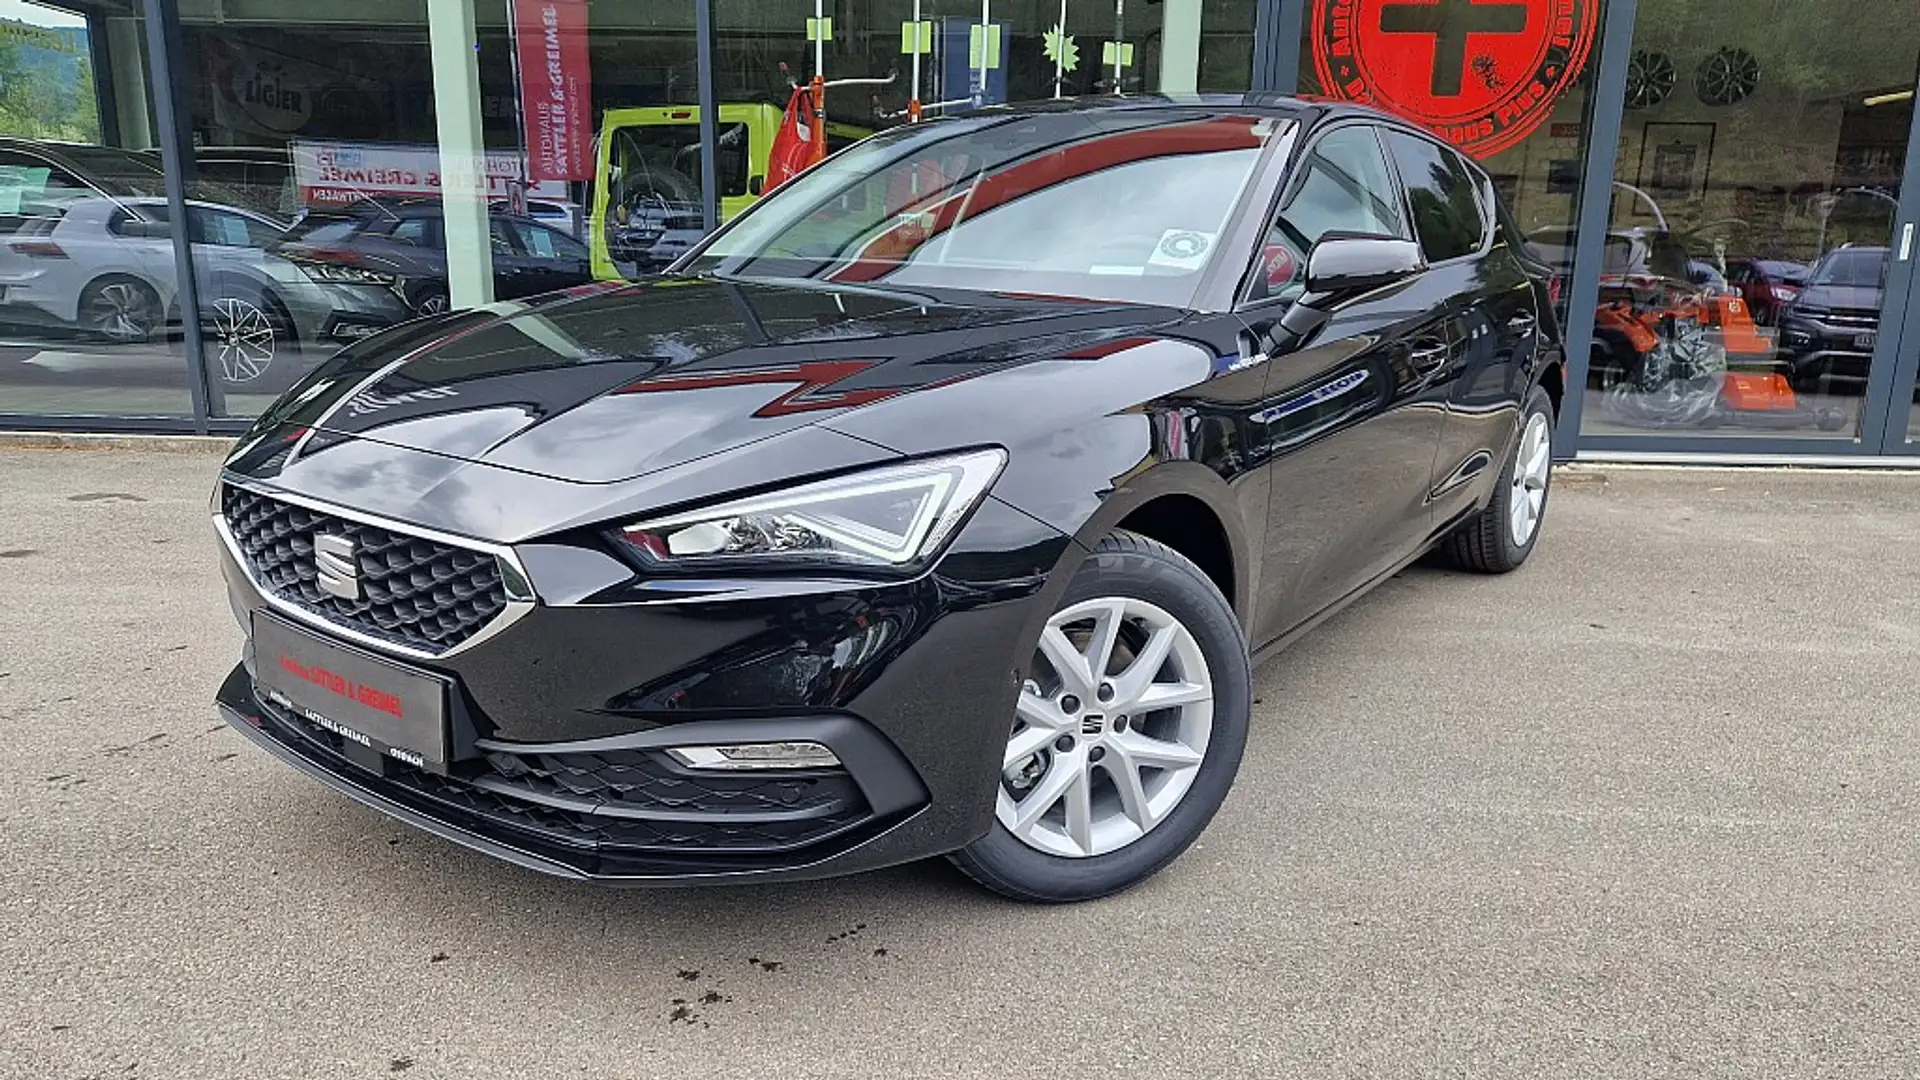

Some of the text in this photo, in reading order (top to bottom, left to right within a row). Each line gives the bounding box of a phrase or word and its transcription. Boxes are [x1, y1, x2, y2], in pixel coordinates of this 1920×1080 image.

[542, 4, 563, 86] GREIMEL
[537, 101, 553, 174] AUTOHAUS
[551, 103, 568, 175] SATTLER
[1496, 80, 1546, 126] Plus
